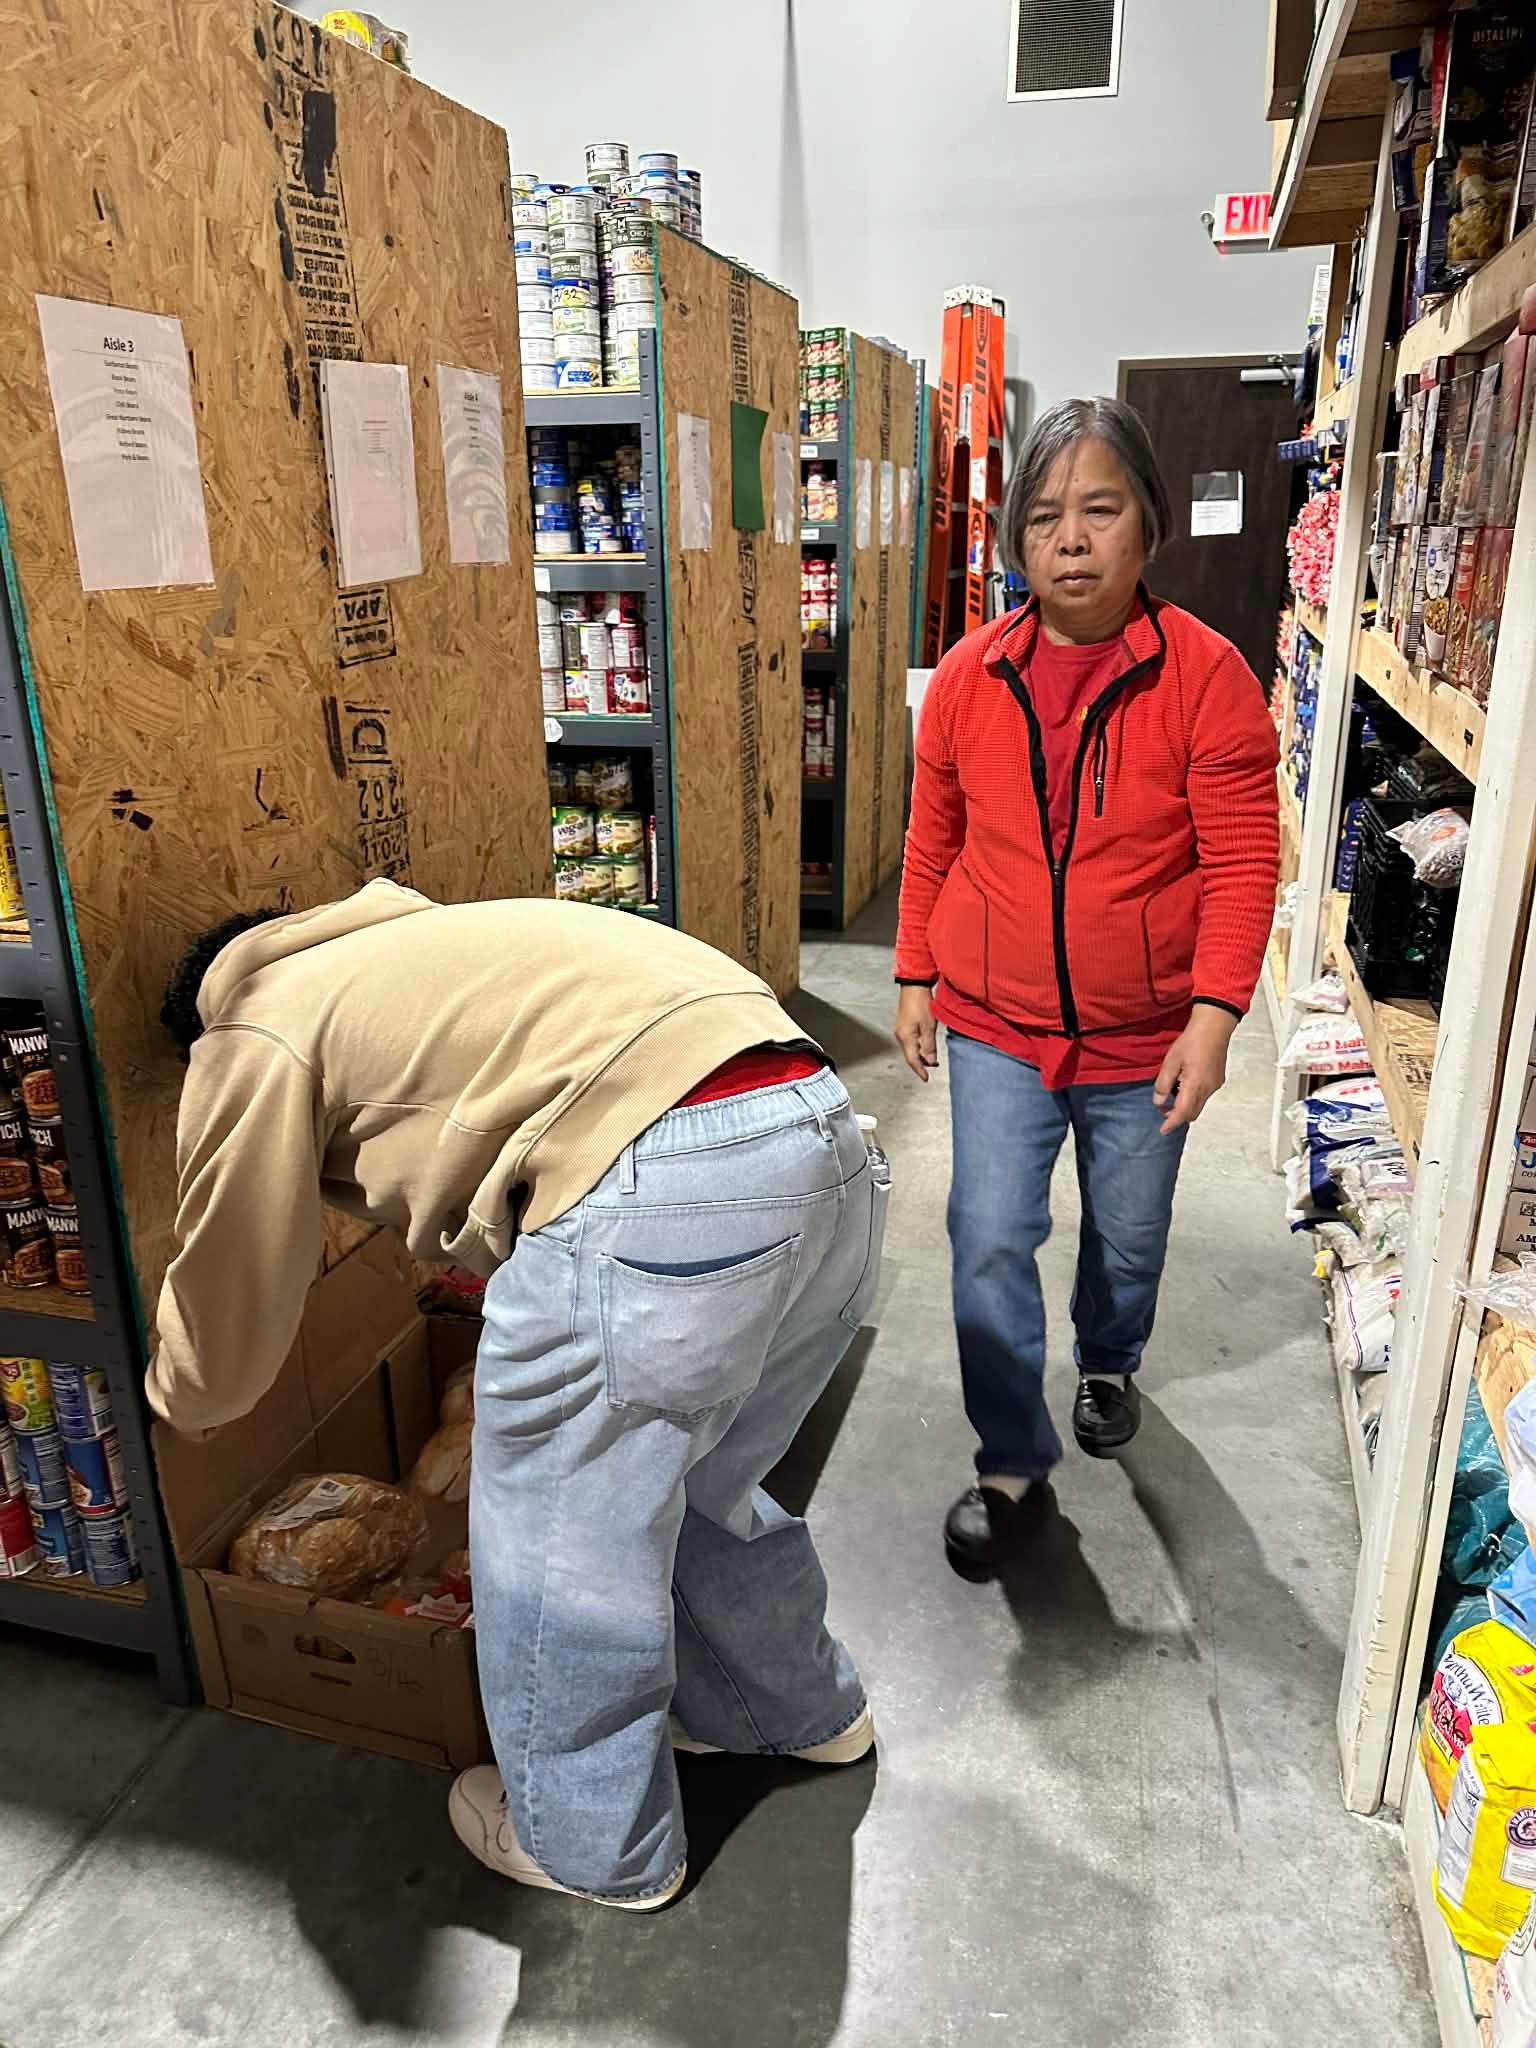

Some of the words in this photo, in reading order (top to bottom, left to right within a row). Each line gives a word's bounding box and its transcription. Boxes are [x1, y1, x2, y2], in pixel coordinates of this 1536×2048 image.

[1225, 194, 1271, 235] EXIT
[103, 337, 126, 351] Aisle
[127, 340, 135, 353] 3
[344, 597, 381, 622] APA
